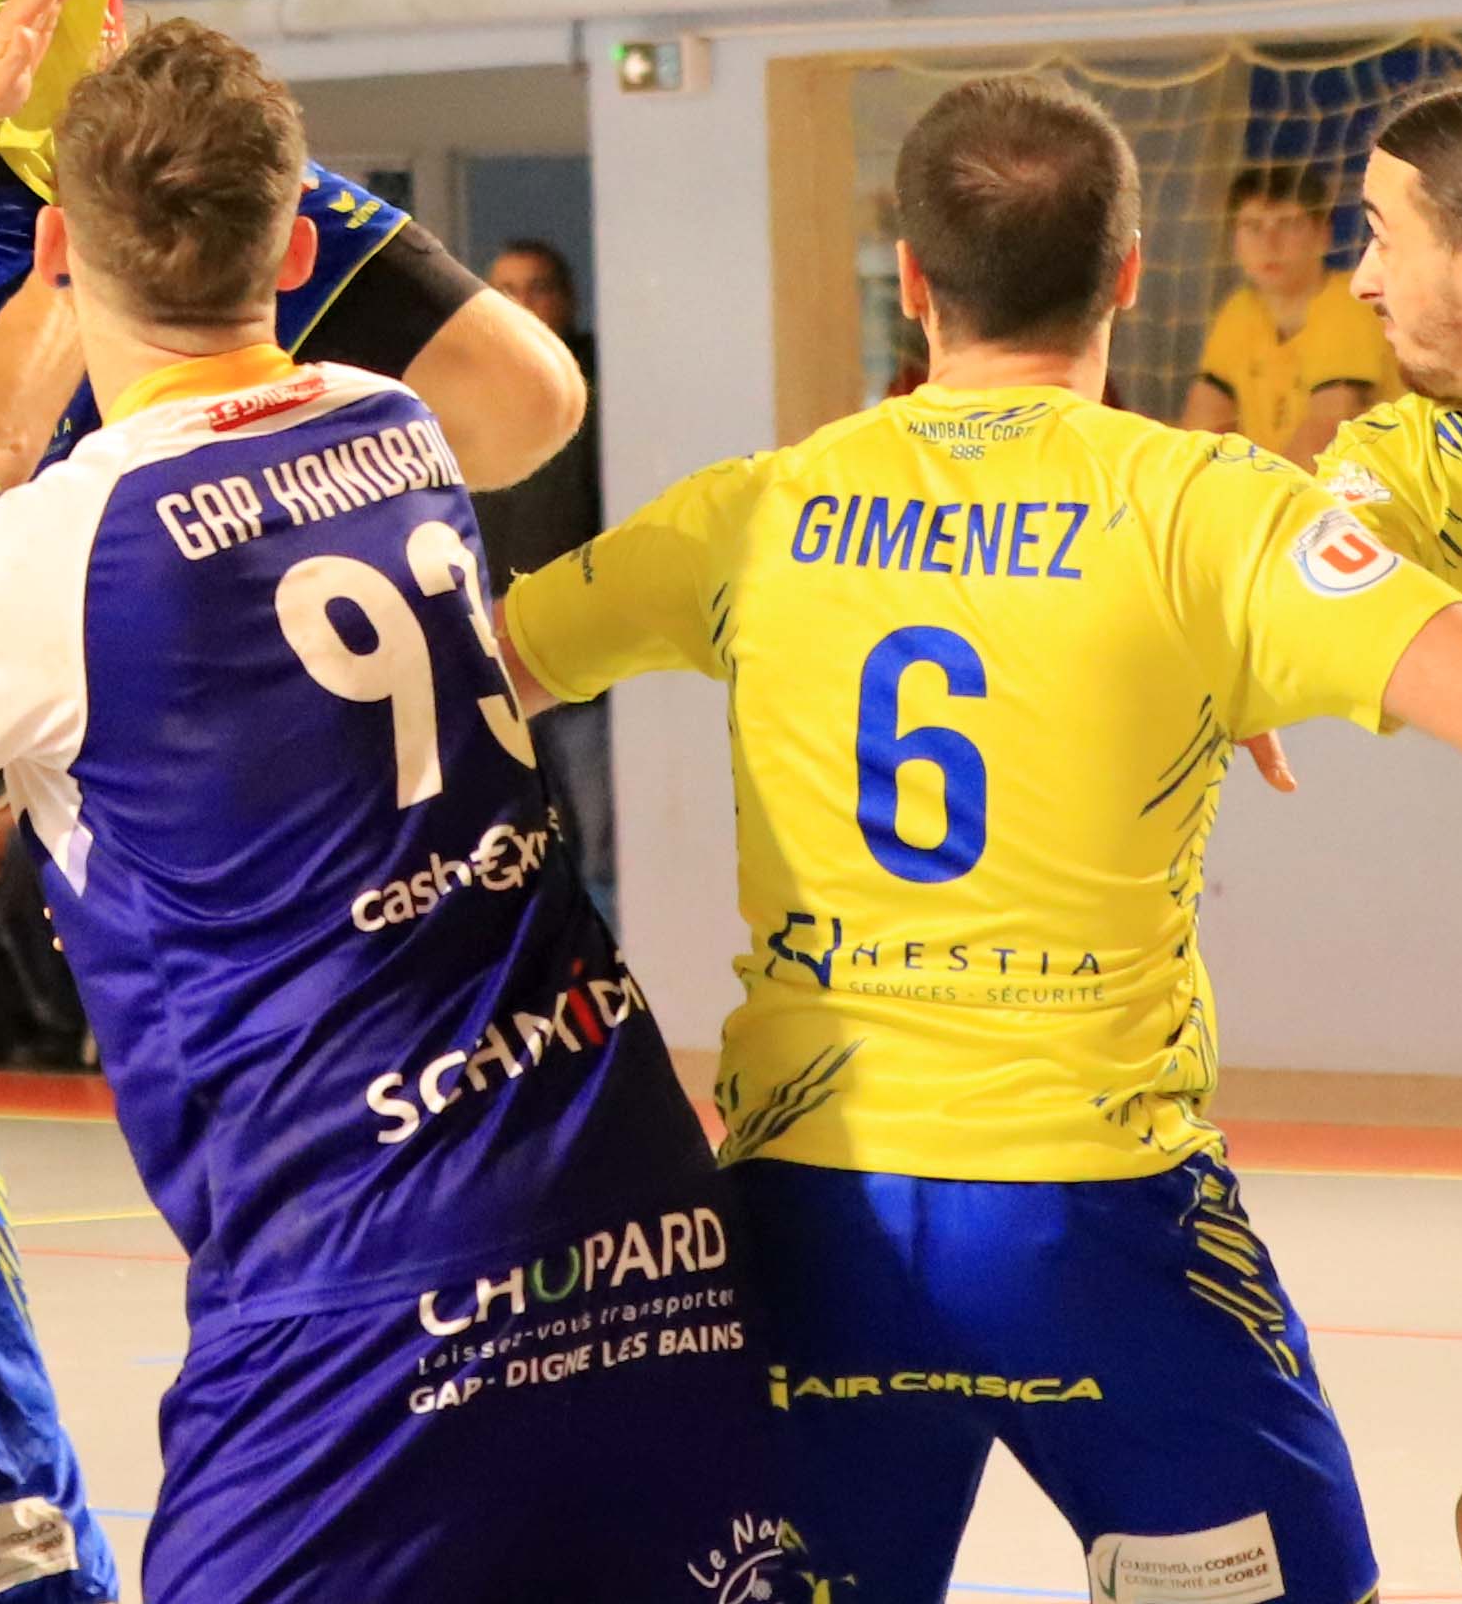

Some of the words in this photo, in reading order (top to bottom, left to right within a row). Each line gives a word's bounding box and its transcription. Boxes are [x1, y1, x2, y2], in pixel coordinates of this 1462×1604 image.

[907, 421, 986, 441] HANDBALL
[950, 444, 986, 461] 1985
[155, 475, 263, 562] GAP
[790, 493, 1090, 580] GIMENEZ
[1319, 532, 1379, 575] U
[274, 519, 538, 811] 93
[855, 624, 988, 884] 6
[851, 941, 1102, 977] HESTIA
[848, 980, 957, 1002] SERVICES
[986, 981, 1106, 1005] SÉCURITÉ
[418, 1206, 728, 1337] CHOPARD
[408, 1376, 484, 1415] GAP
[505, 1344, 594, 1388] DIGNE
[601, 1331, 649, 1369] LES
[657, 1321, 745, 1358] BAINS
[792, 1375, 883, 1400] AIR
[889, 1371, 1104, 1404] CORSICA
[687, 1548, 727, 1589] Le
[1204, 1546, 1267, 1573] CORSICA
[1224, 1562, 1270, 1585] CORSE
